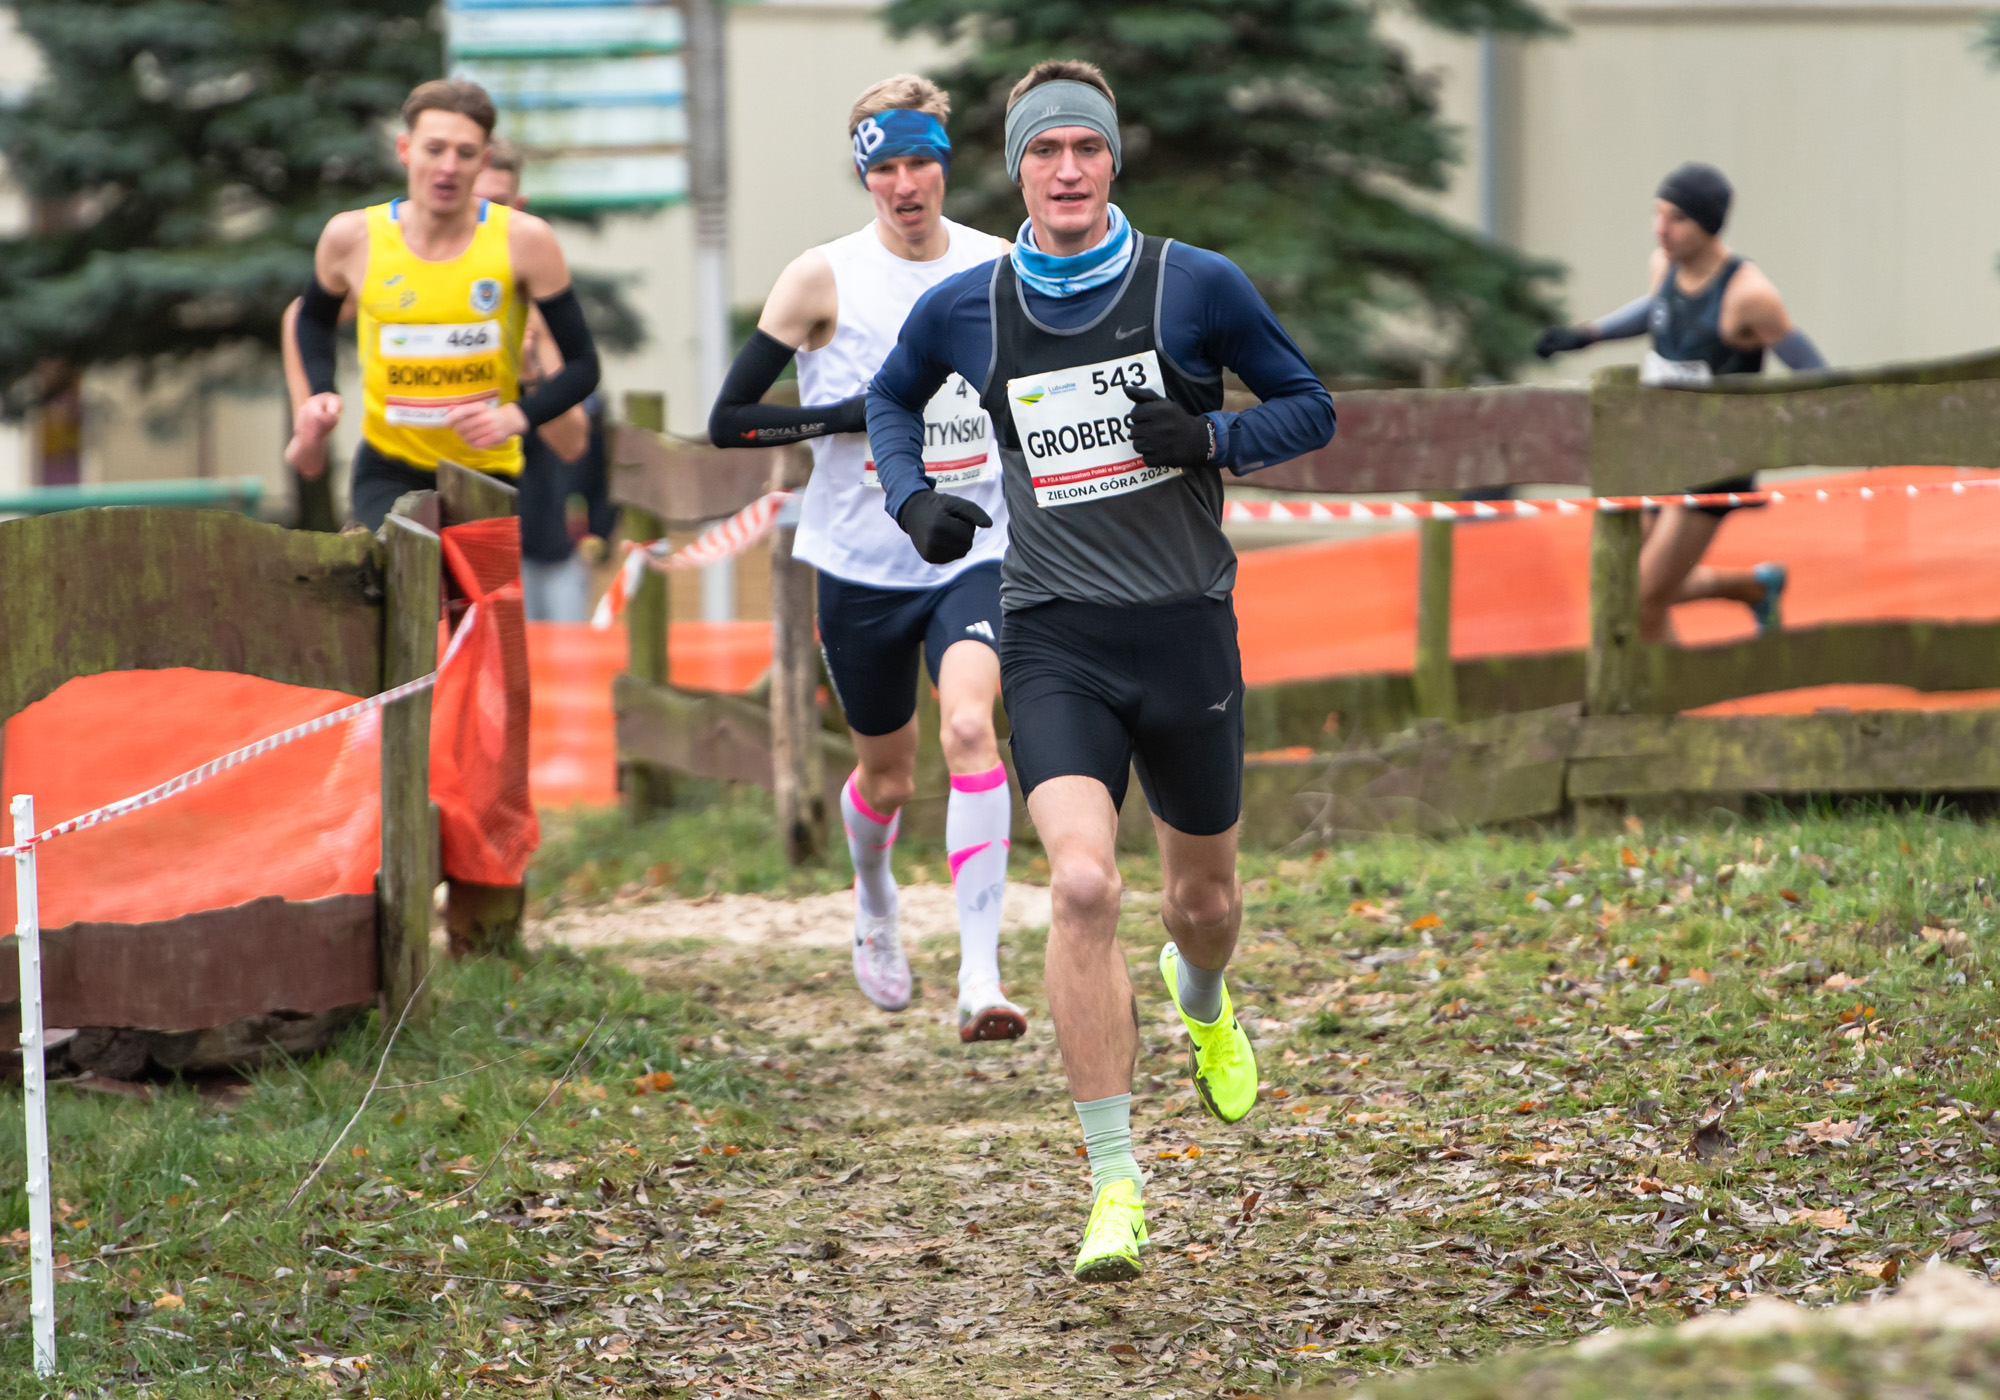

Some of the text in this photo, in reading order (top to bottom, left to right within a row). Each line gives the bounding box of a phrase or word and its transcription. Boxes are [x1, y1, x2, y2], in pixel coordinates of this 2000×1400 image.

[447, 327, 488, 347] 466
[387, 360, 495, 386] BOROWSKI
[1092, 362, 1147, 395] 543
[956, 379, 968, 399] 4
[757, 422, 825, 437] ROYAL BAY
[1091, 467, 1107, 477] Polski
[1047, 465, 1170, 501] ZIELONA GÓRA 2023
